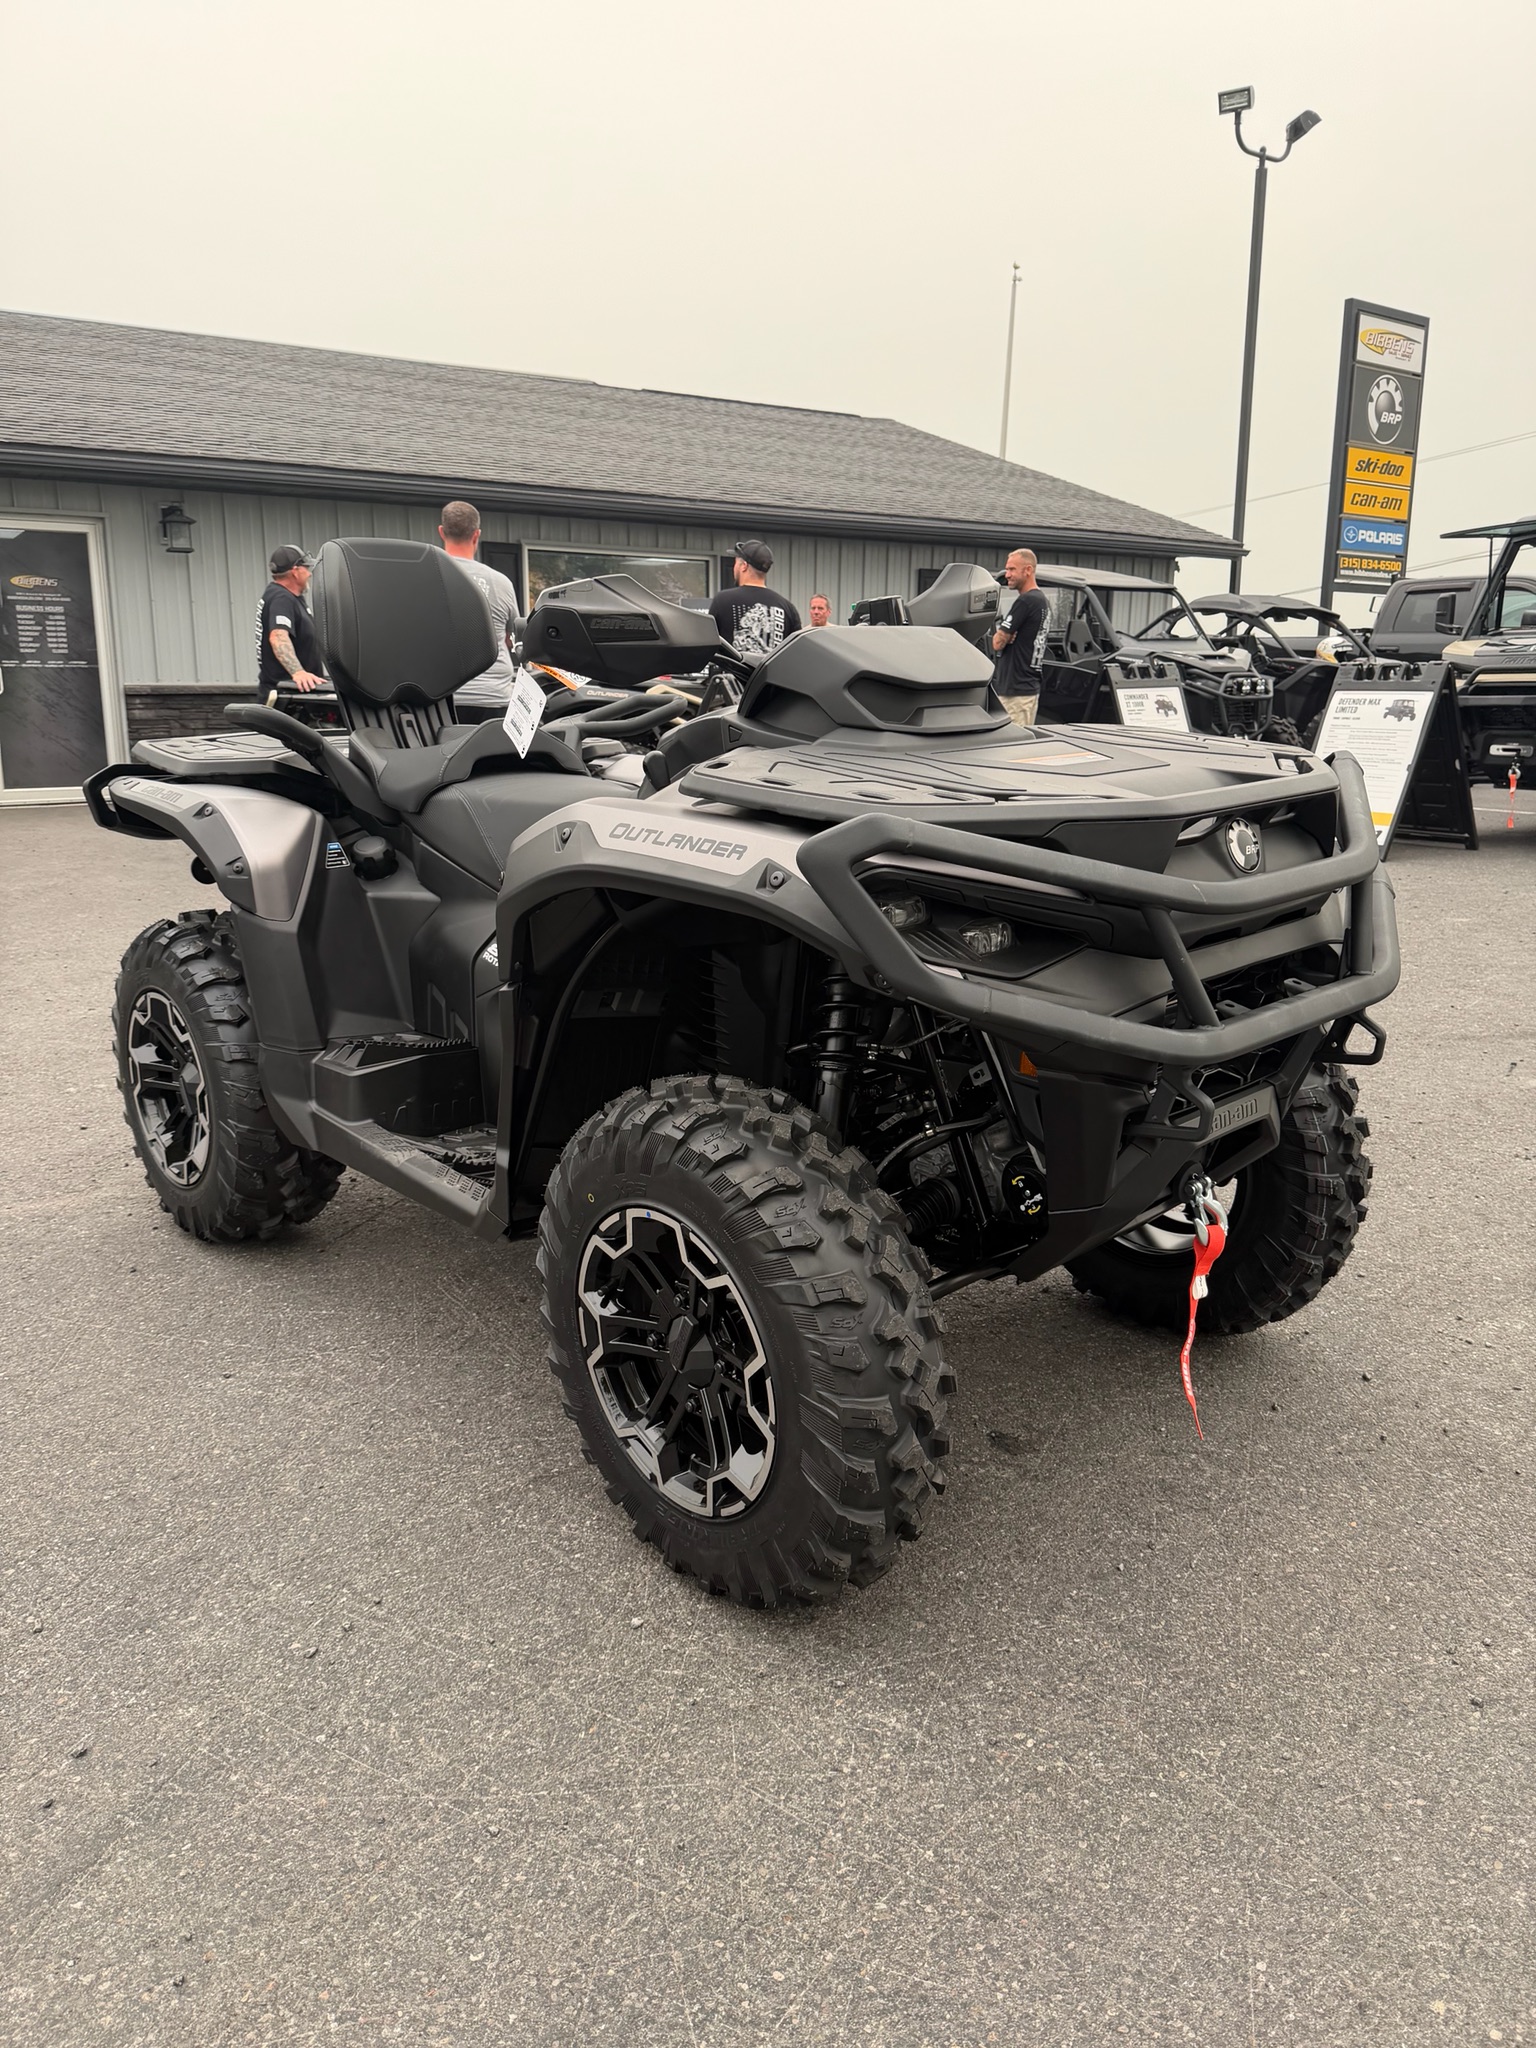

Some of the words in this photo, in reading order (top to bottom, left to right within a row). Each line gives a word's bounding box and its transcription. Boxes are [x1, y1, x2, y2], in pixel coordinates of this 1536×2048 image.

[1365, 331, 1415, 355] BIBBENS
[1380, 411, 1402, 426] BRP
[1355, 456, 1404, 477] ski-doo
[1350, 491, 1403, 511] can-am
[1358, 529, 1404, 546] POLARIS
[1339, 556, 1361, 569] (315)
[1361, 559, 1402, 572] 834-6500
[590, 617, 654, 630] can-am
[586, 689, 629, 698] OUTLANDER
[1124, 693, 1149, 701] COMMANDER
[141, 785, 184, 803] can-am
[608, 822, 748, 861] OUTLANDER
[1245, 844, 1259, 855] BRP
[1210, 1097, 1259, 1133] an-am
